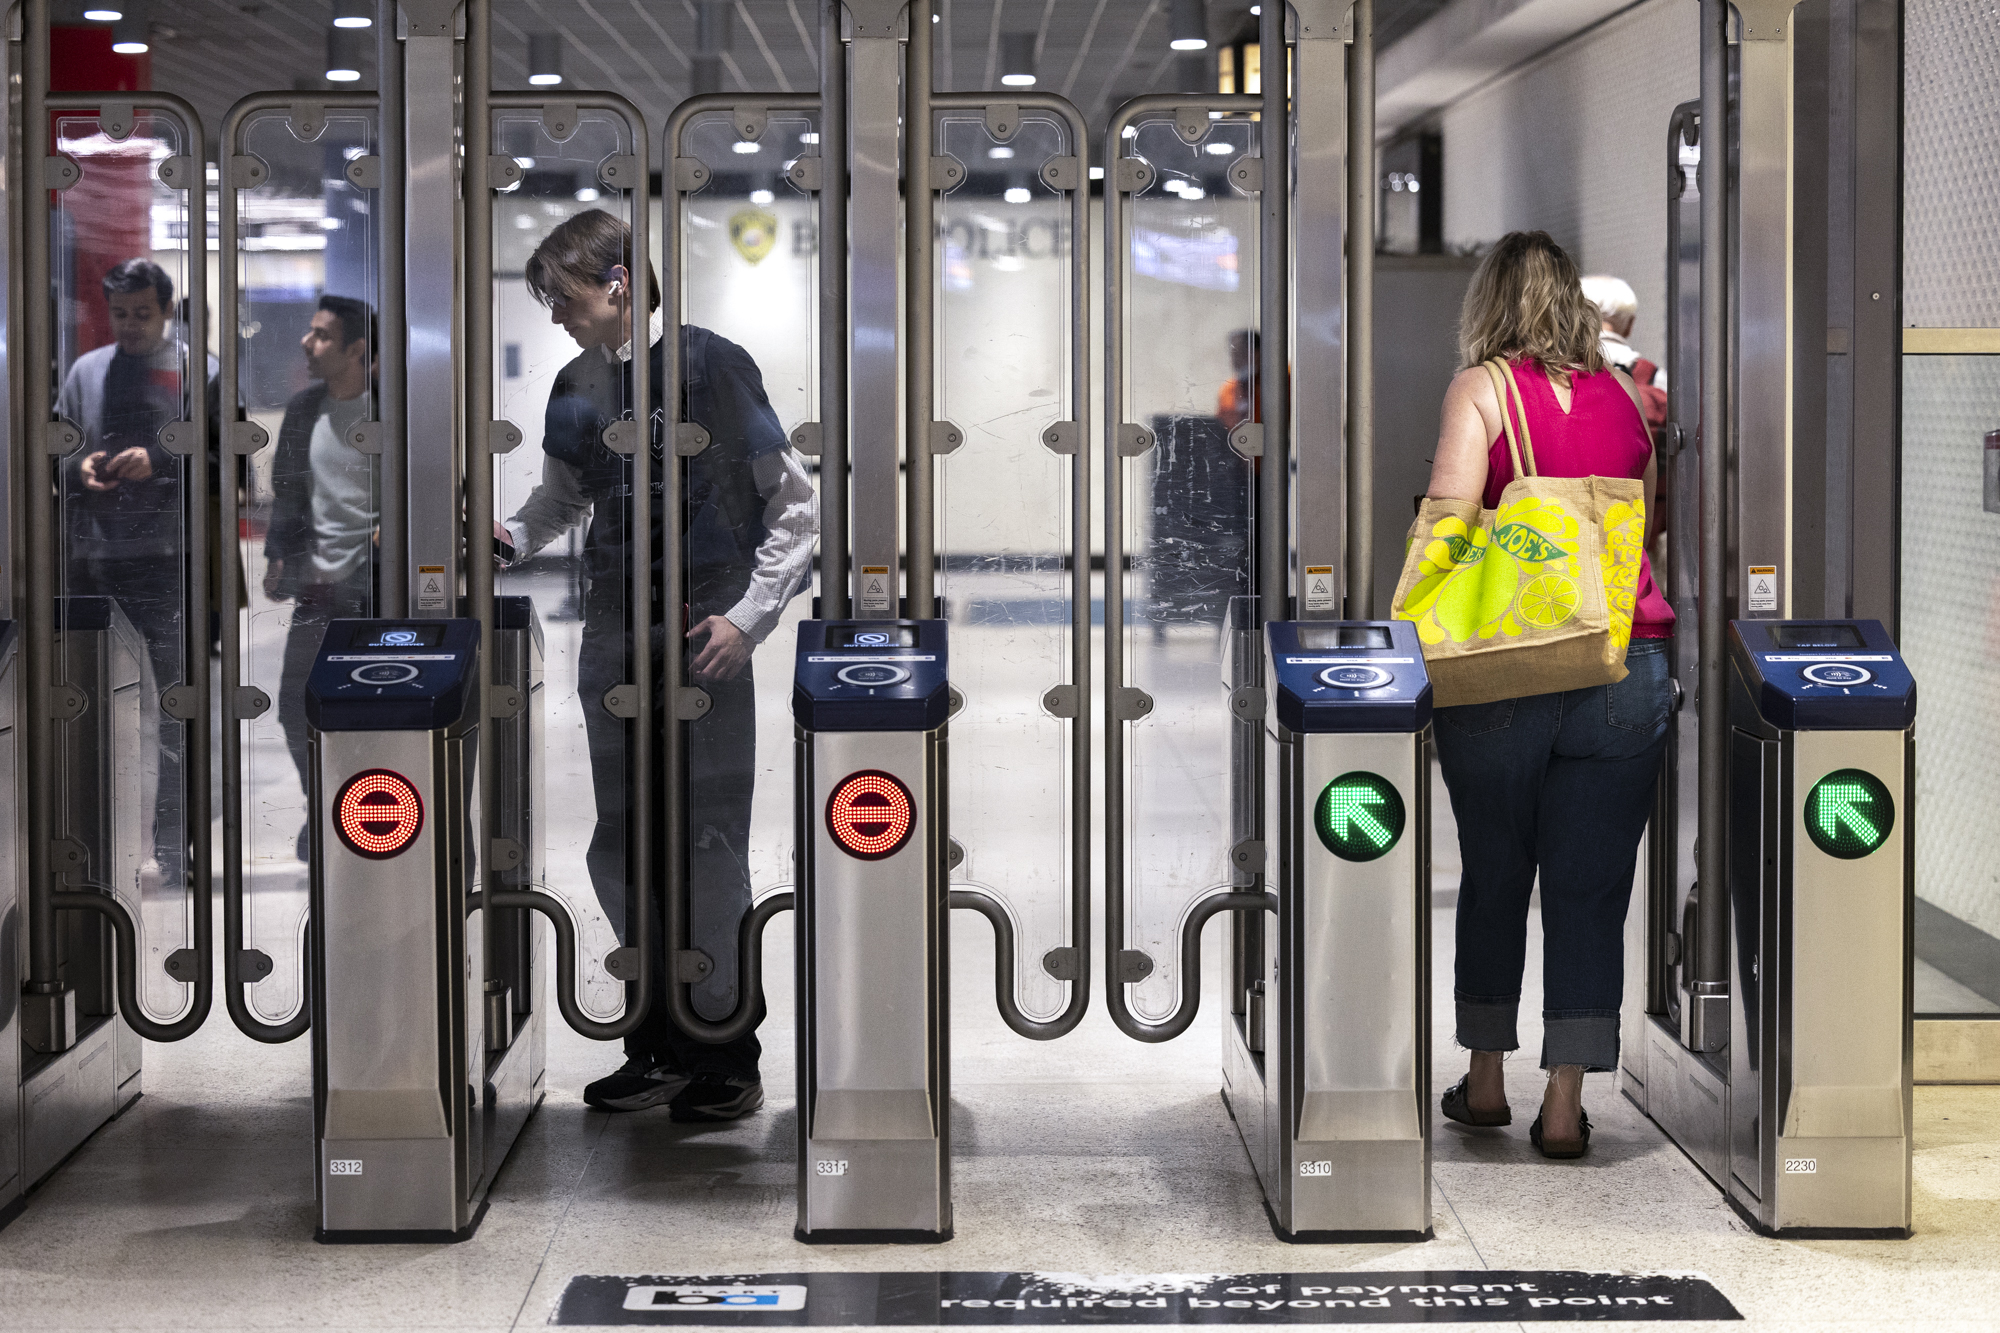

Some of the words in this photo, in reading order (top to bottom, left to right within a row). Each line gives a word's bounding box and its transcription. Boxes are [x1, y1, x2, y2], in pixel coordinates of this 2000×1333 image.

[331, 1161, 361, 1173] 3312
[818, 1162, 846, 1173] 3311
[1300, 1162, 1331, 1174] 3310
[1786, 1160, 1816, 1172] 2230
[1226, 1284, 1281, 1294] of
[1300, 1283, 1538, 1296] payment
[941, 1297, 1167, 1310] required
[1188, 1297, 1391, 1310] beyond
[1409, 1296, 1509, 1306] this
[1528, 1295, 1673, 1308] point
